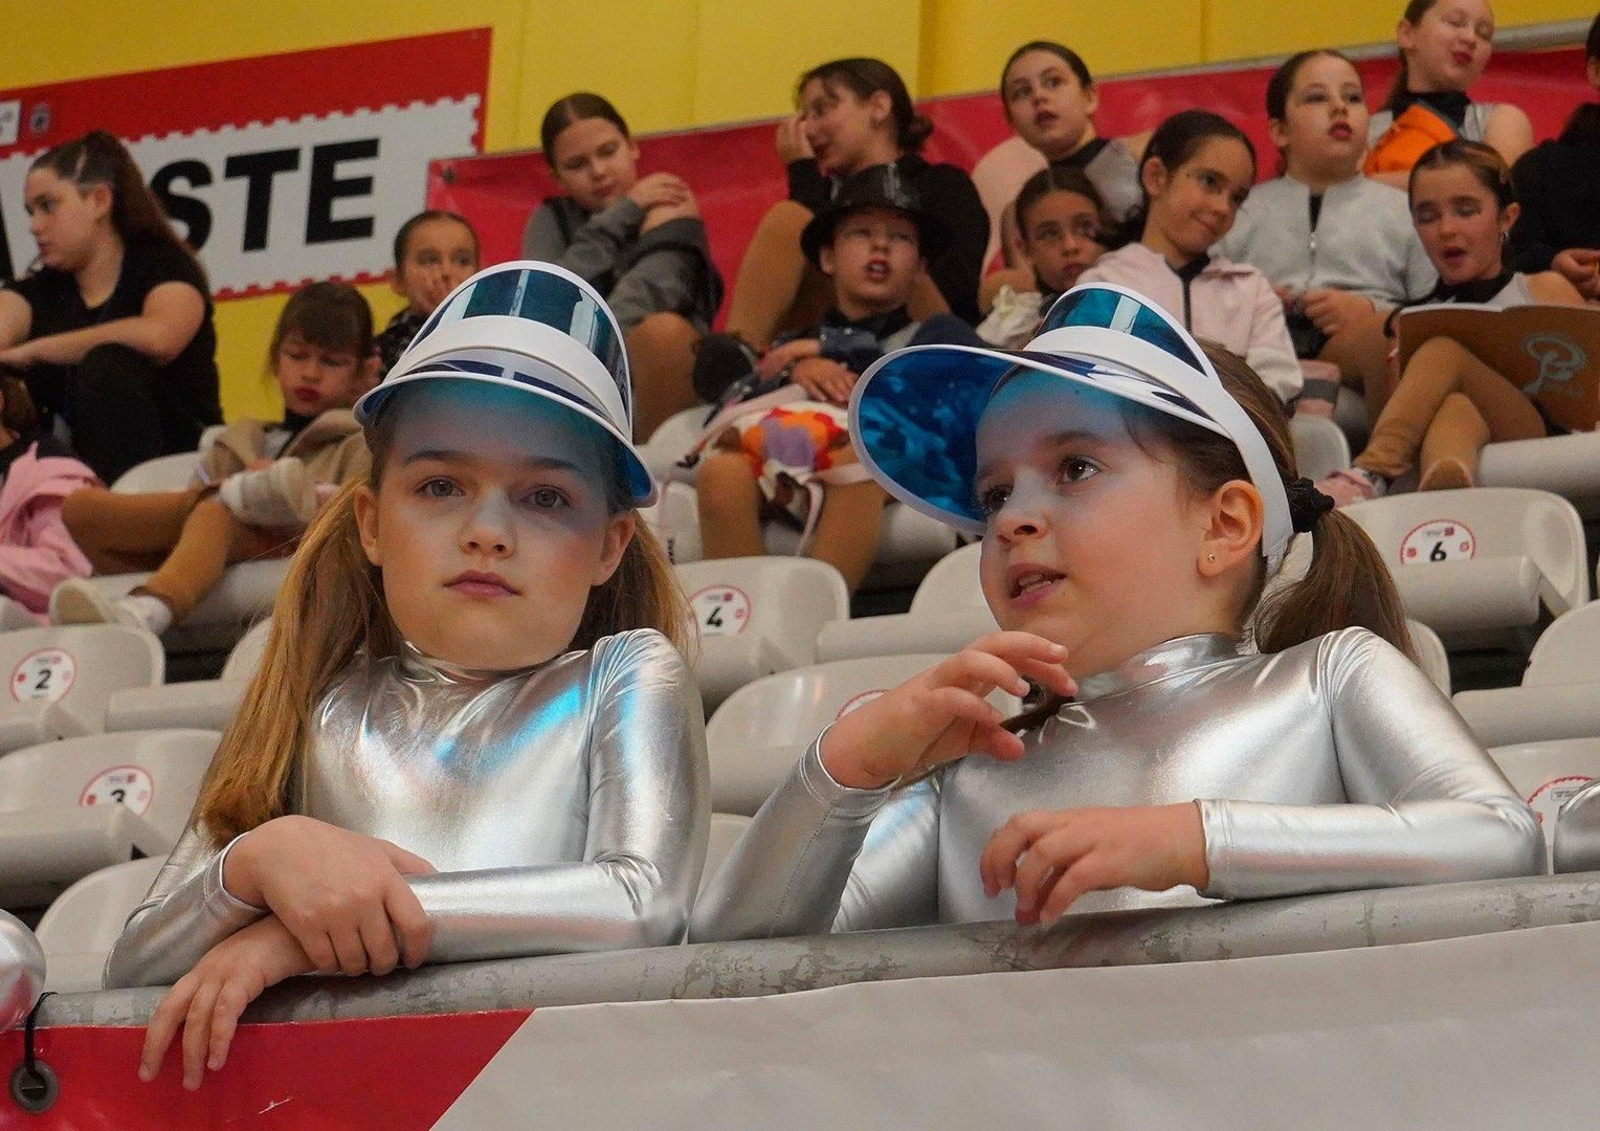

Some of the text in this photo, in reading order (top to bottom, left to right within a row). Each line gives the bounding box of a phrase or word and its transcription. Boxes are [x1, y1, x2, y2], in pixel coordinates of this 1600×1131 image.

[150, 138, 379, 252] STE
[1430, 541, 1447, 562] 6
[706, 606, 723, 627] 4
[35, 668, 51, 690] 2
